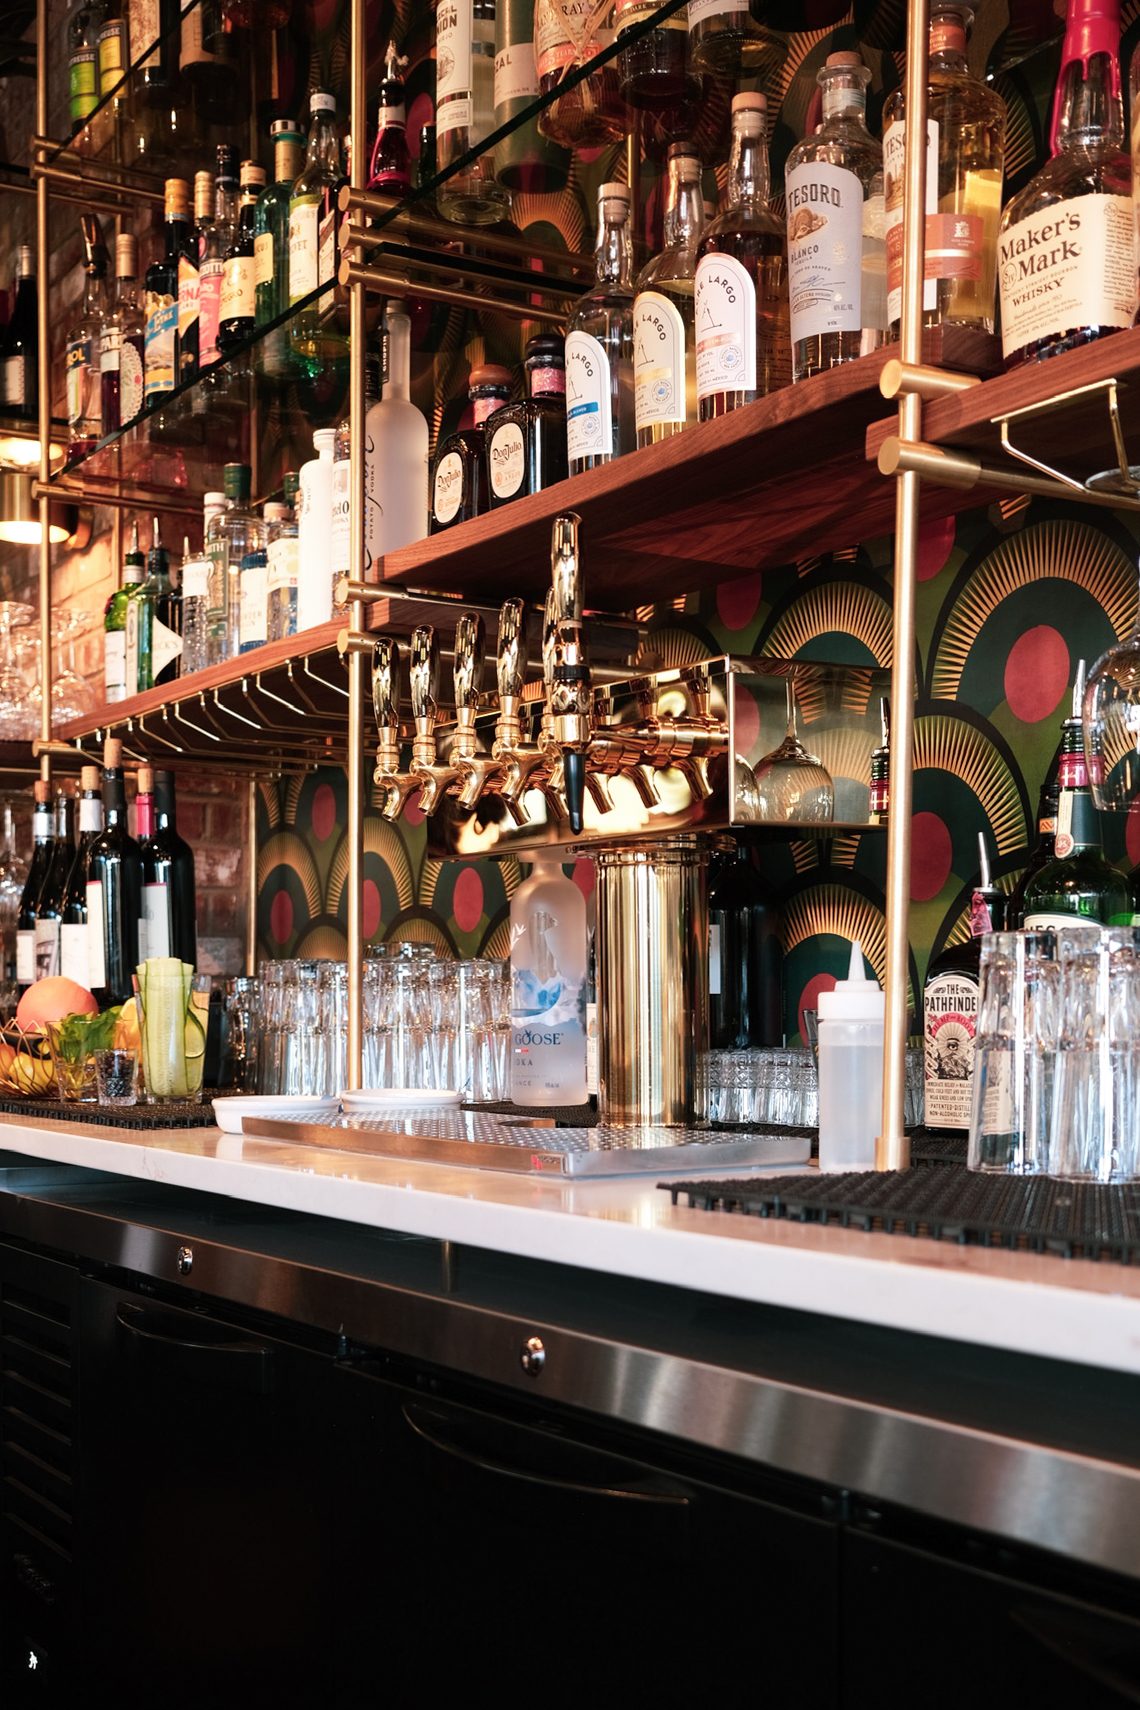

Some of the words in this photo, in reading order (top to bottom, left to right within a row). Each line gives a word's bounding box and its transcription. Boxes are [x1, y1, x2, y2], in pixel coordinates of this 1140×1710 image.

[788, 183, 841, 213] TESORO
[1000, 212, 1081, 266] Maker's
[1018, 240, 1080, 281] Mark
[708, 275, 736, 304] LARGO
[1012, 277, 1064, 307] WHISKY
[642, 314, 667, 341] LARGO
[571, 352, 594, 377] LARGO
[946, 984, 959, 995] THE
[925, 996, 979, 1012] PATHFINDE
[514, 1031, 561, 1046] GOOSE
